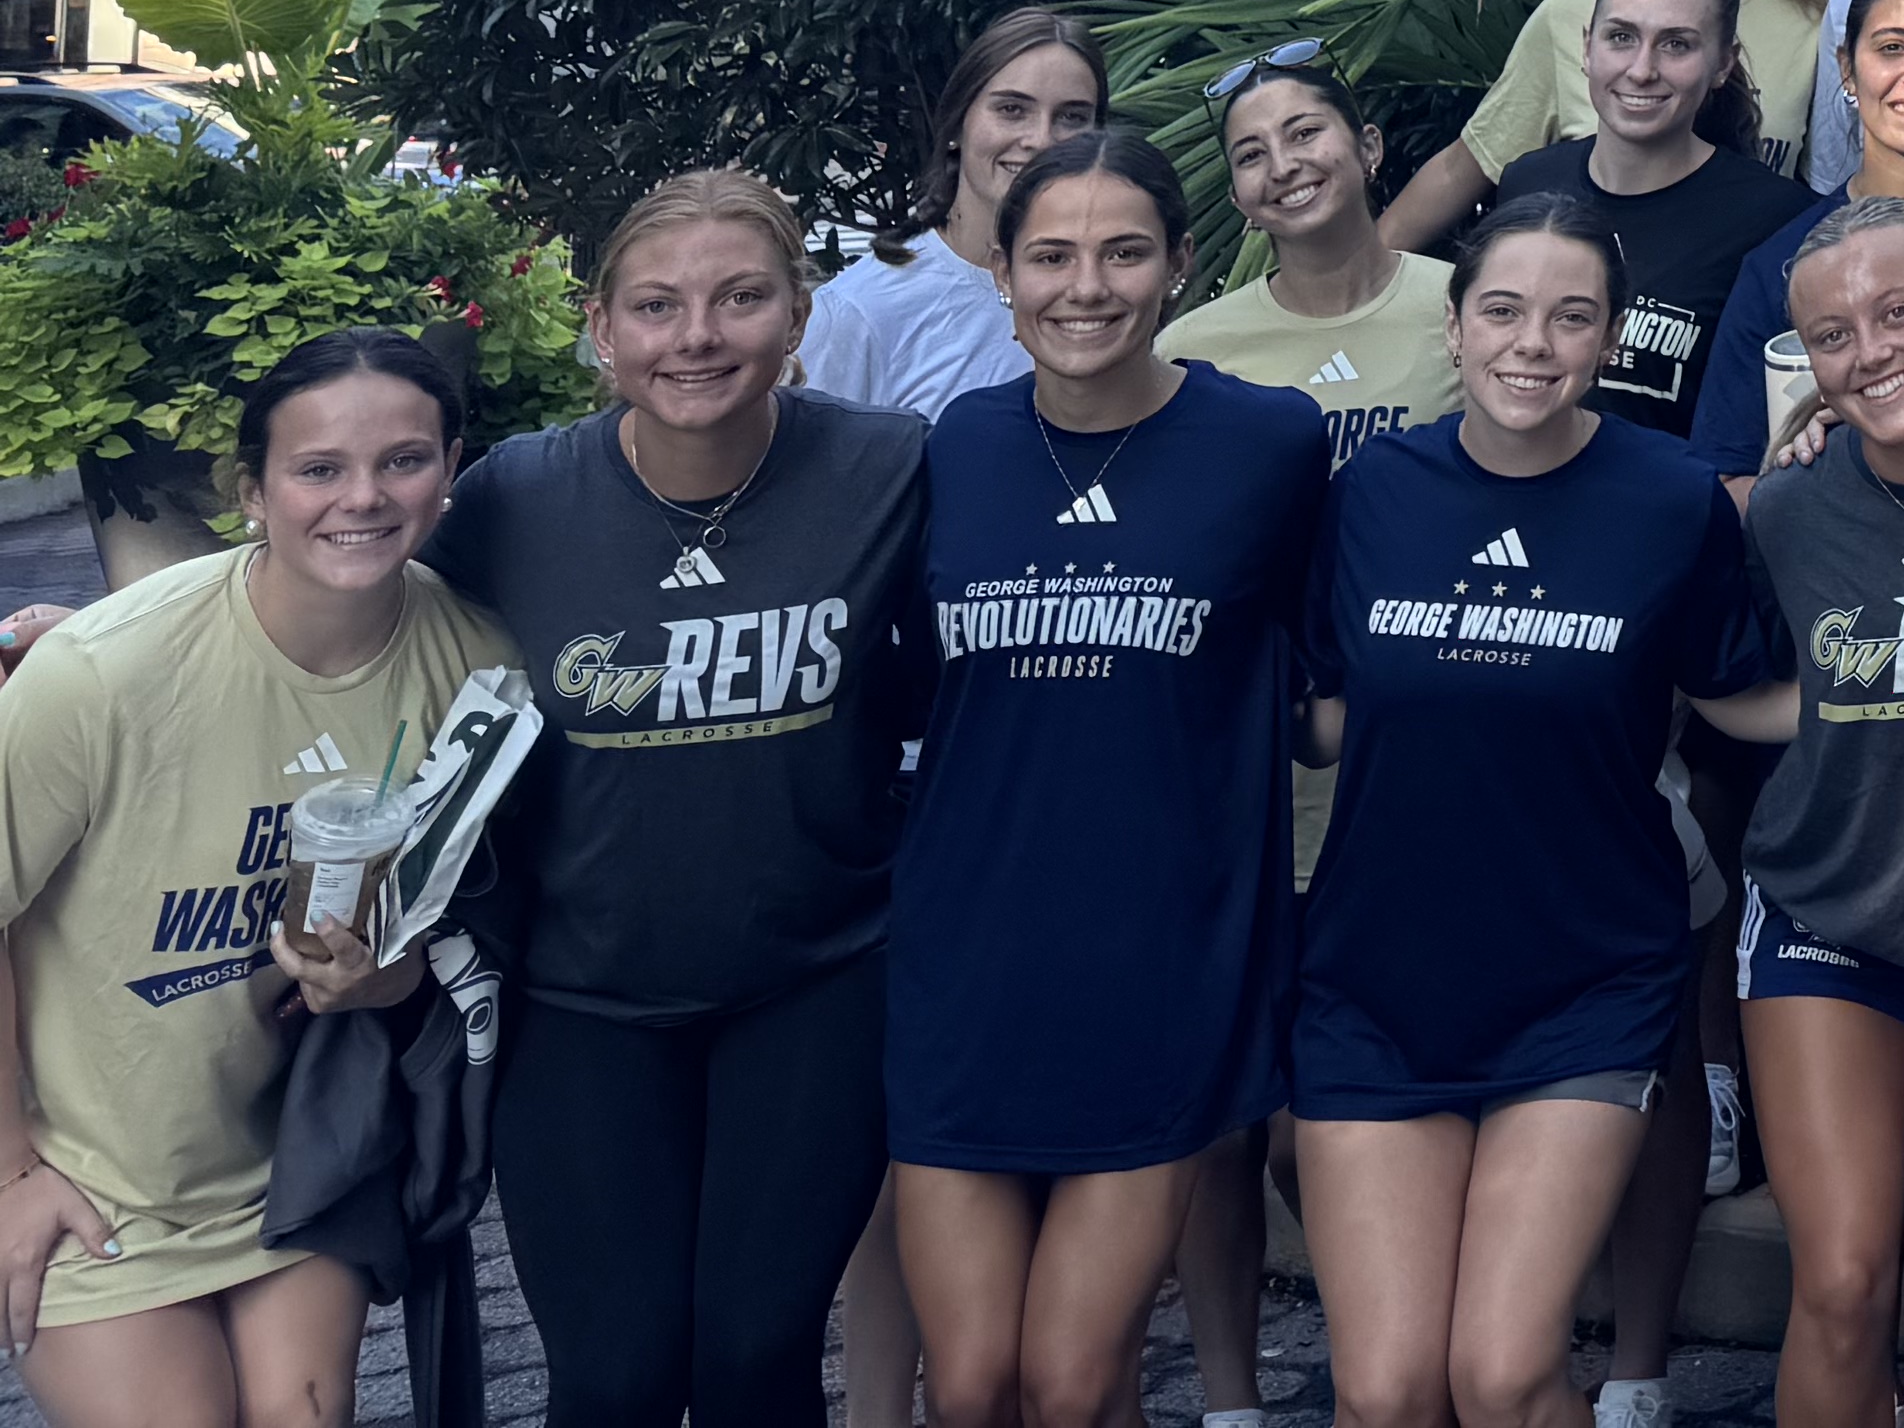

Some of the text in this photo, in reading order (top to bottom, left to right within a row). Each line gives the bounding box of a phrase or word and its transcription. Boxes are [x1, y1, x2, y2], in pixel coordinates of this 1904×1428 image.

[1636, 295, 1656, 308] DC
[965, 577, 1174, 599] GEORGE WASHINGTON
[937, 594, 1212, 661] REVOLUTIONARIES
[1368, 599, 1624, 654] GEORGE WASHINGTON
[553, 597, 848, 722] GW REVS
[1010, 655, 1114, 678] LACROSSE
[1437, 647, 1532, 666] LACROSSE
[622, 721, 774, 745] LACROSSE
[152, 960, 254, 1002] LACROSSE
